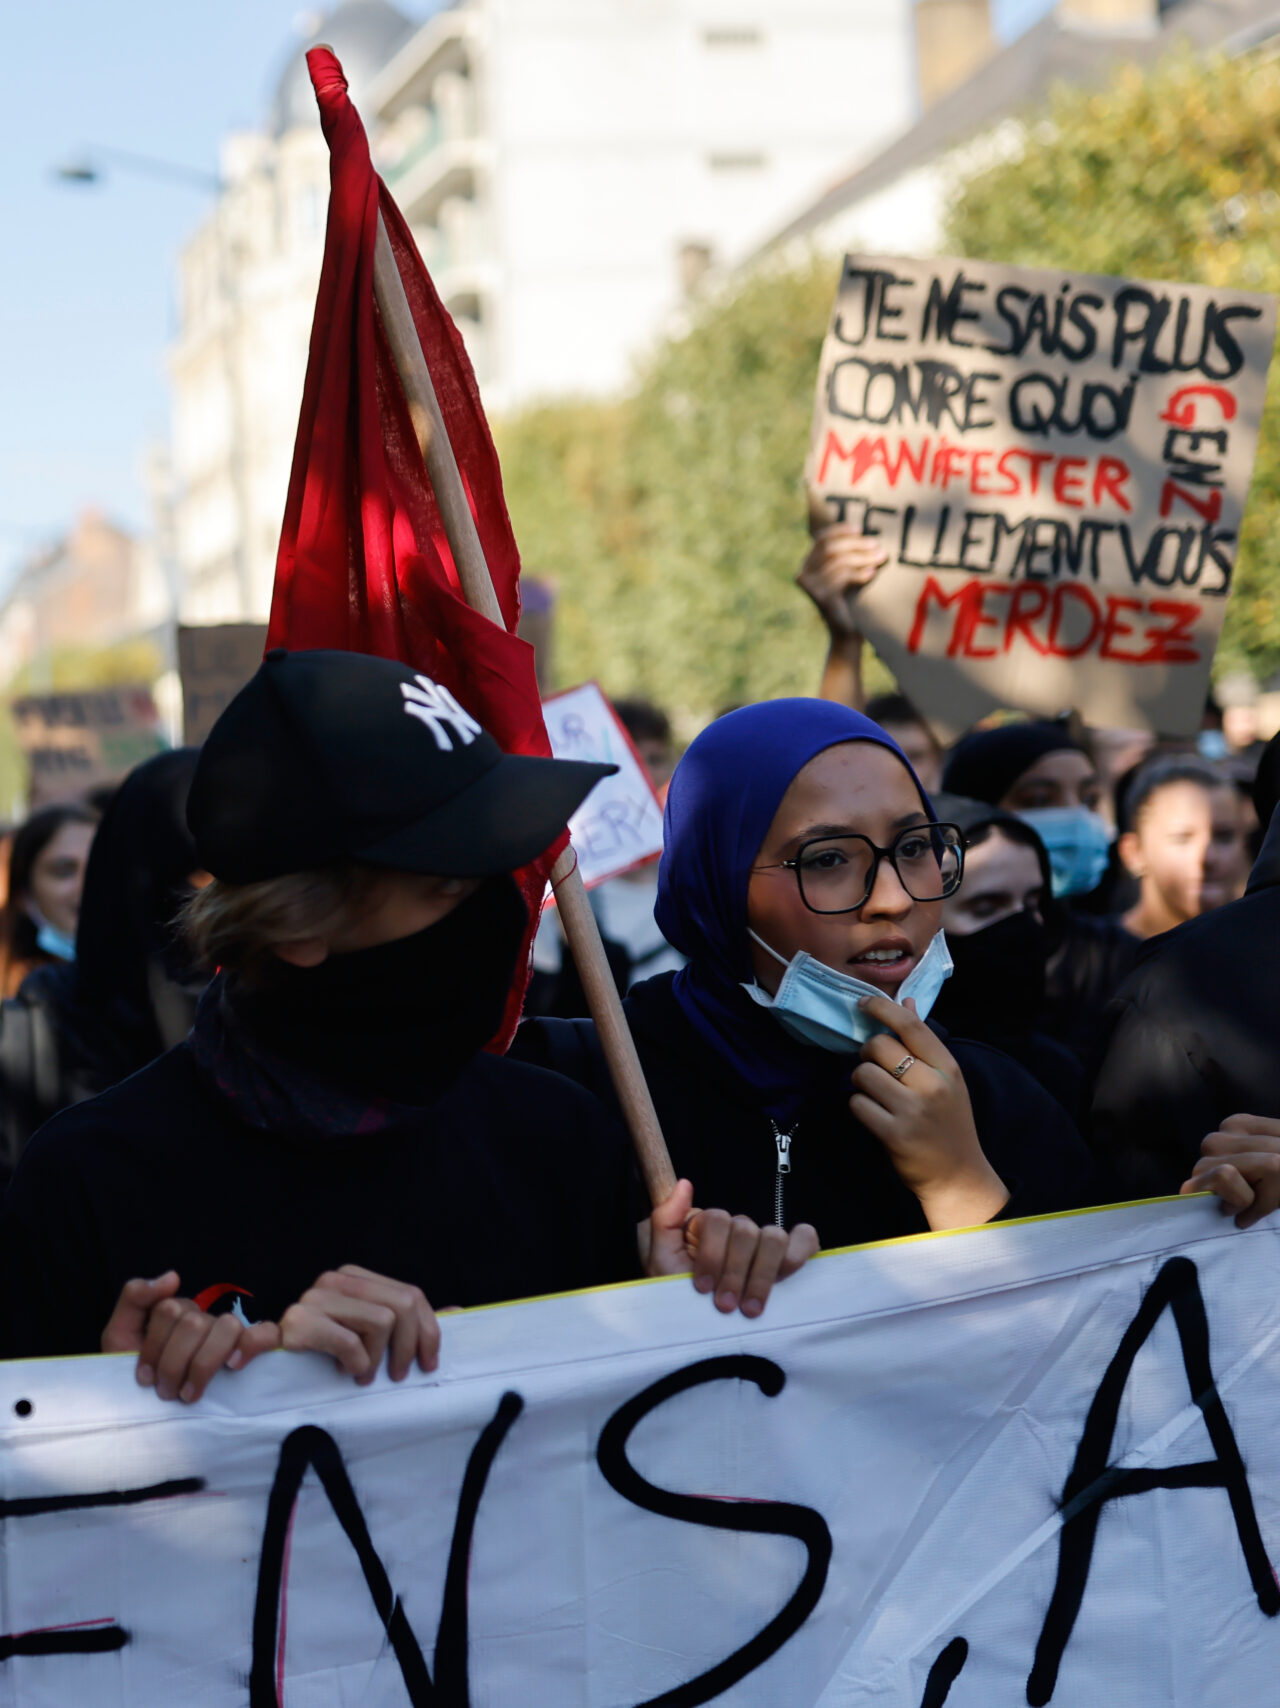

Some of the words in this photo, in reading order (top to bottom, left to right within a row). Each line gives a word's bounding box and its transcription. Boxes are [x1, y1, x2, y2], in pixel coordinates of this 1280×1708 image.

[834, 266, 915, 346] JE
[920, 270, 987, 350] NE
[1111, 284, 1262, 380] PLUS
[826, 357, 1002, 432] CONTRE
[1114, 518, 1235, 598] VOUS
[907, 574, 1203, 664] MERDEZ
